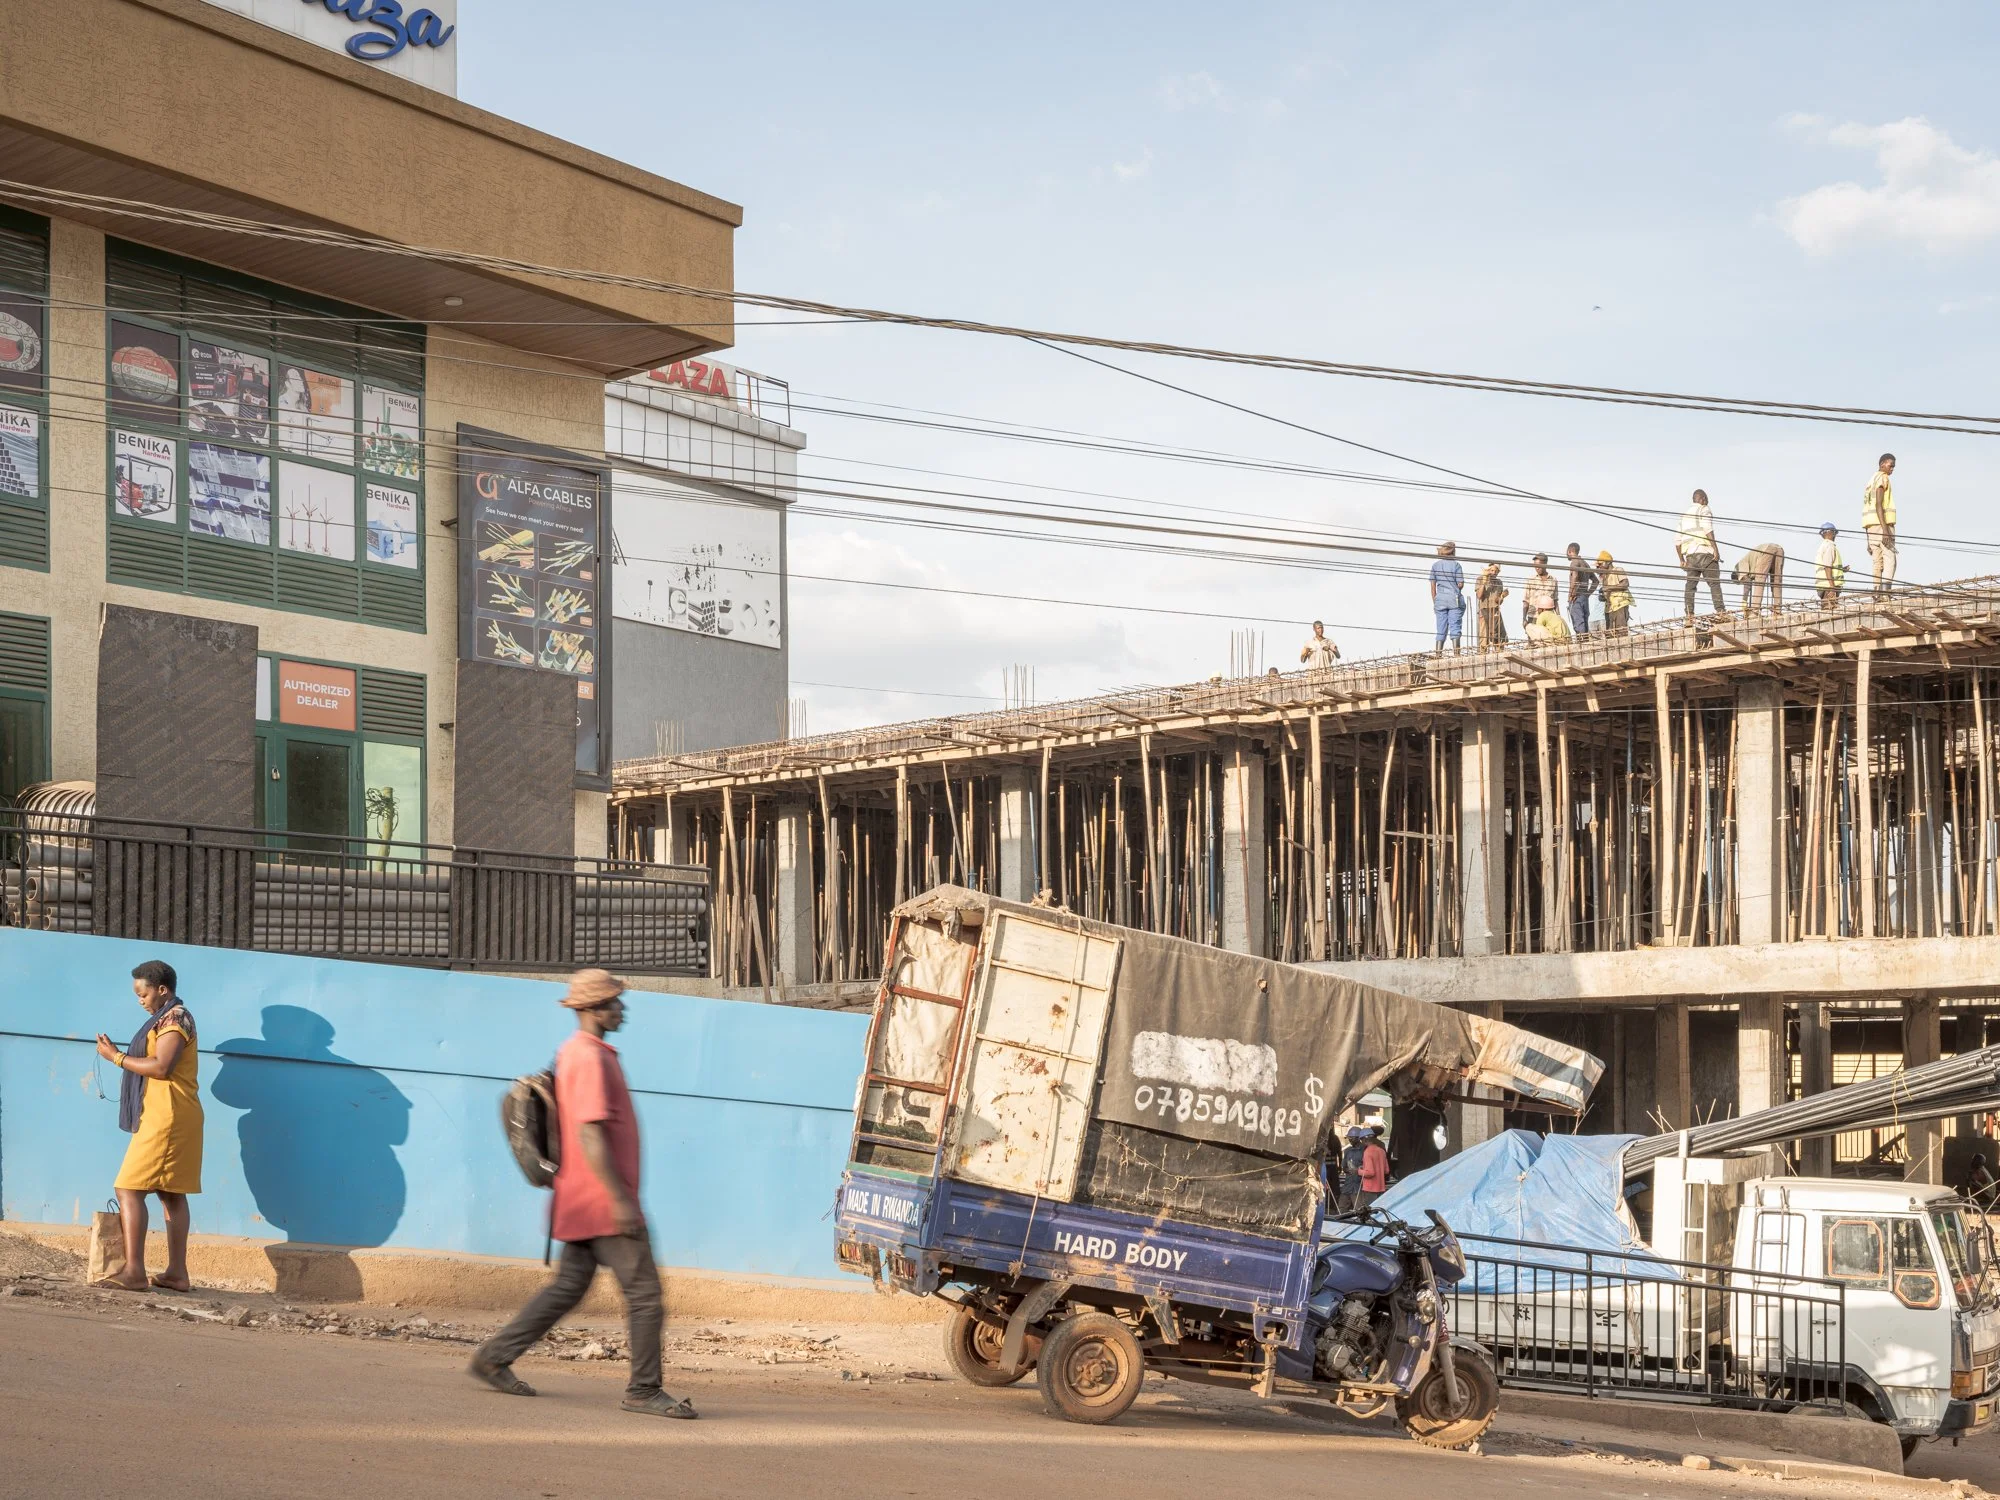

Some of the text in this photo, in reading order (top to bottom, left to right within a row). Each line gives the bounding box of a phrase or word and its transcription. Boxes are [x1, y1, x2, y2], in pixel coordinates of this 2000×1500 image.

[142, 450, 171, 460] Hardware
[507, 478, 592, 509] ALFA CABLES
[485, 506, 496, 514] See
[542, 520, 555, 528] your
[555, 522, 569, 531] every
[284, 679, 351, 697] AUTHORIZED
[297, 695, 338, 710] DEALER
[1304, 1072, 1324, 1118] $
[847, 1188, 919, 1226] MADE IN RWANDA
[1054, 1231, 1187, 1271] HARD BODY
